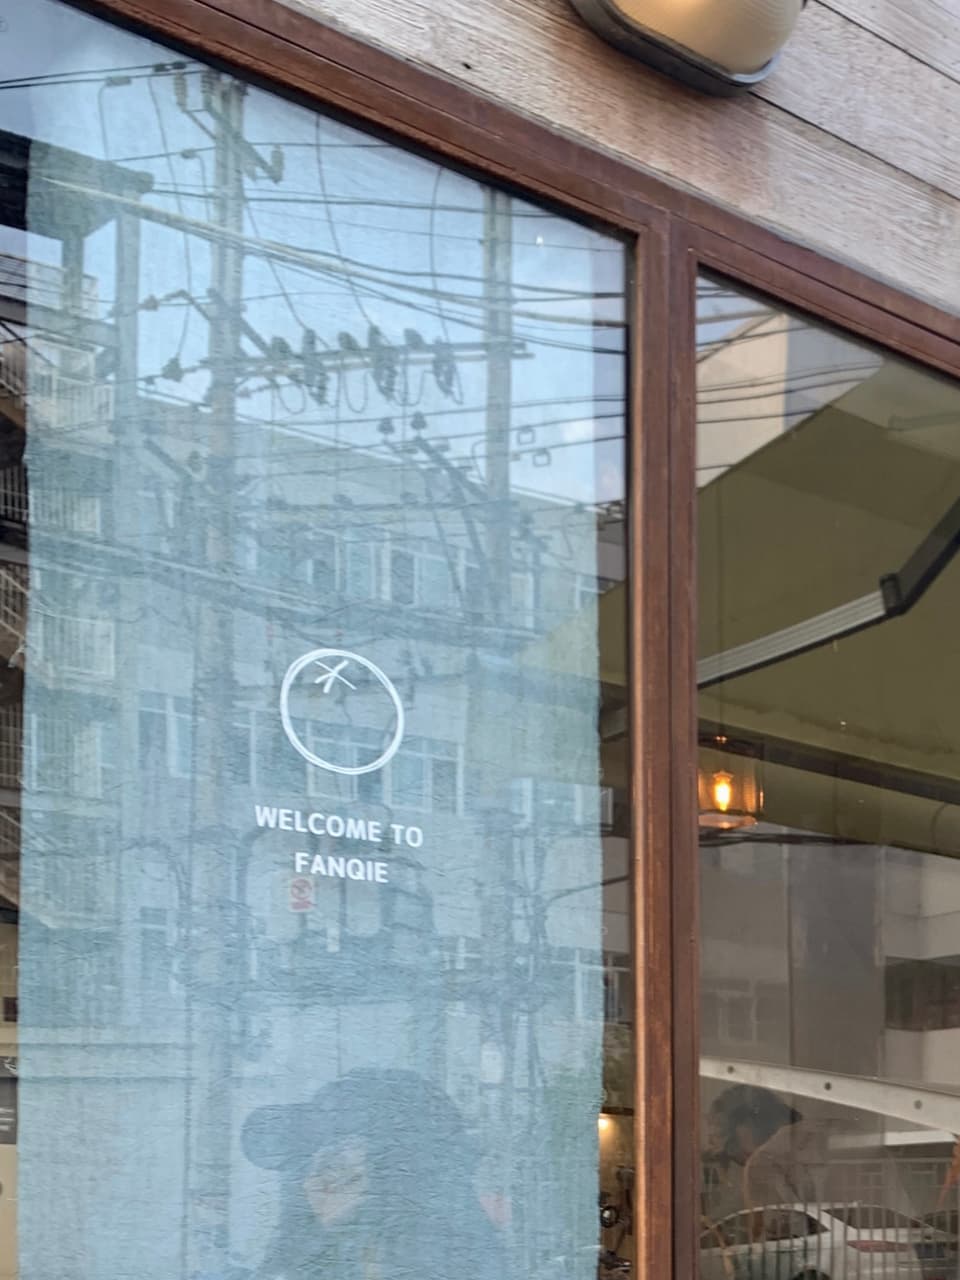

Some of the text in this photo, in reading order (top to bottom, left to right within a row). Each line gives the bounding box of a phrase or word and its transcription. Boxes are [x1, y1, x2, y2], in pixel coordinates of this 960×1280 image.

[255, 805, 423, 848] WELCOME TO
[295, 852, 389, 883] FANQIE
